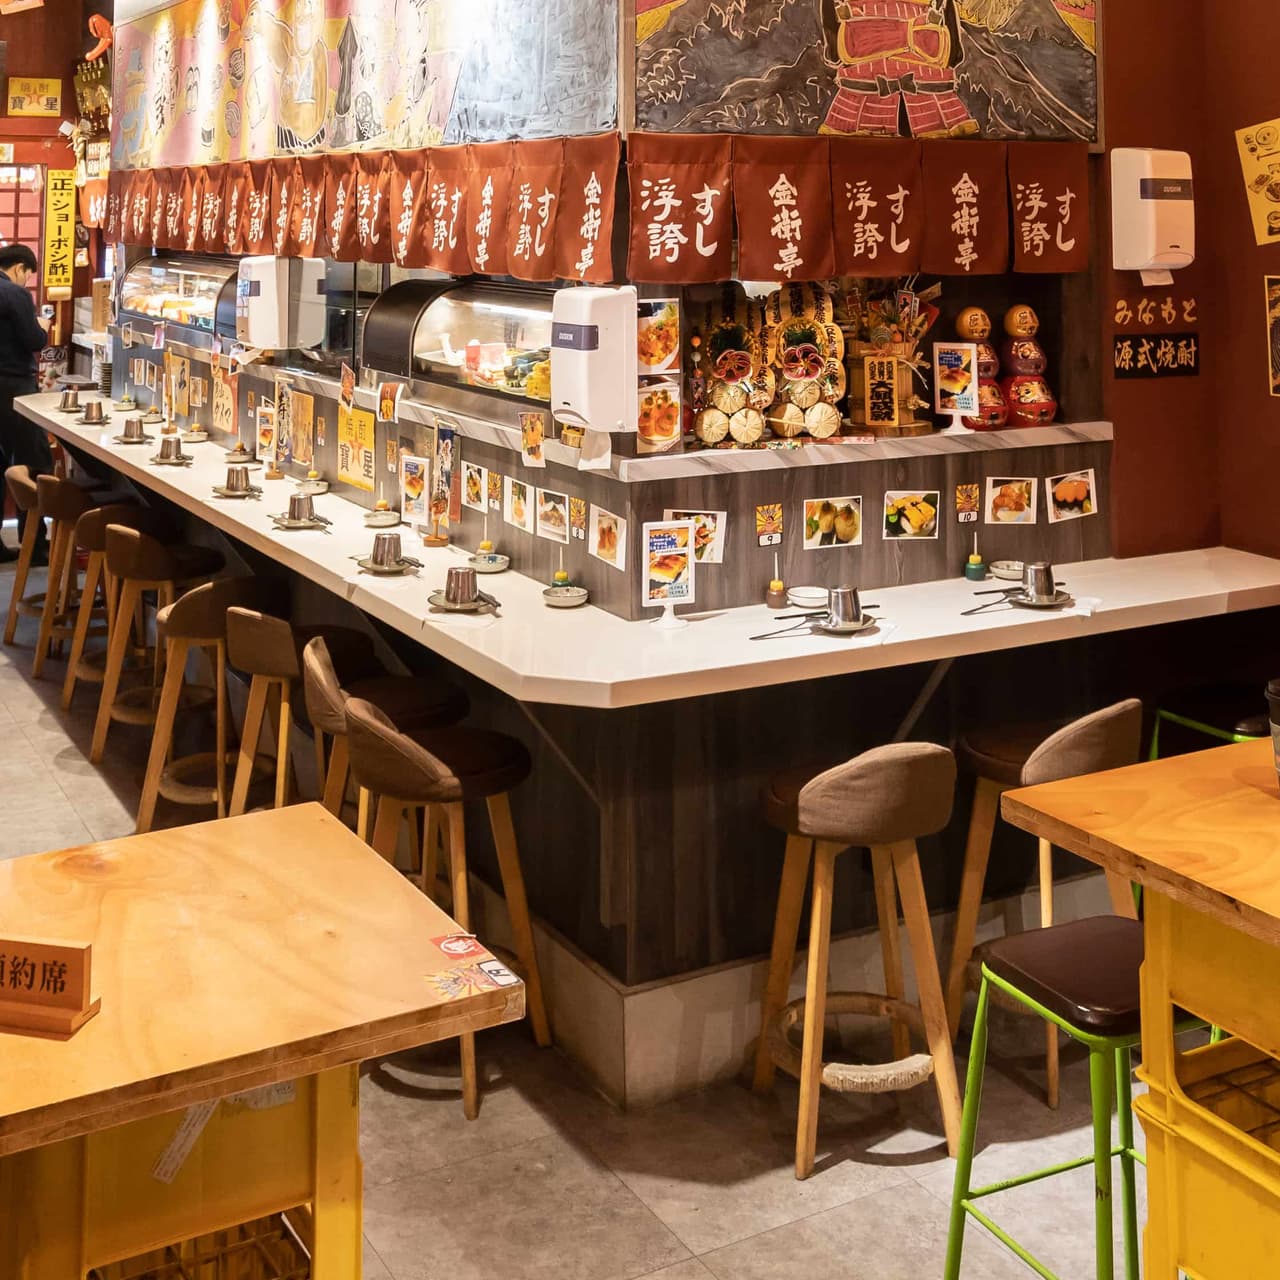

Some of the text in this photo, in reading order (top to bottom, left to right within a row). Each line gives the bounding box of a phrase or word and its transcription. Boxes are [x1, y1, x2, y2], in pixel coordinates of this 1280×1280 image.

[52, 179, 73, 191] 正
[370, 188, 382, 244] すし
[448, 186, 462, 250] すし
[886, 184, 910, 253] すし
[534, 186, 555, 256] すし
[640, 178, 688, 263] 浮誇
[692, 183, 721, 257] すし
[846, 180, 884, 260] 浮誇
[1016, 182, 1051, 257] 浮誇
[1056, 187, 1076, 252] すし
[1114, 297, 1197, 325] みなもと
[1114, 338, 1197, 374] 源式焼酎
